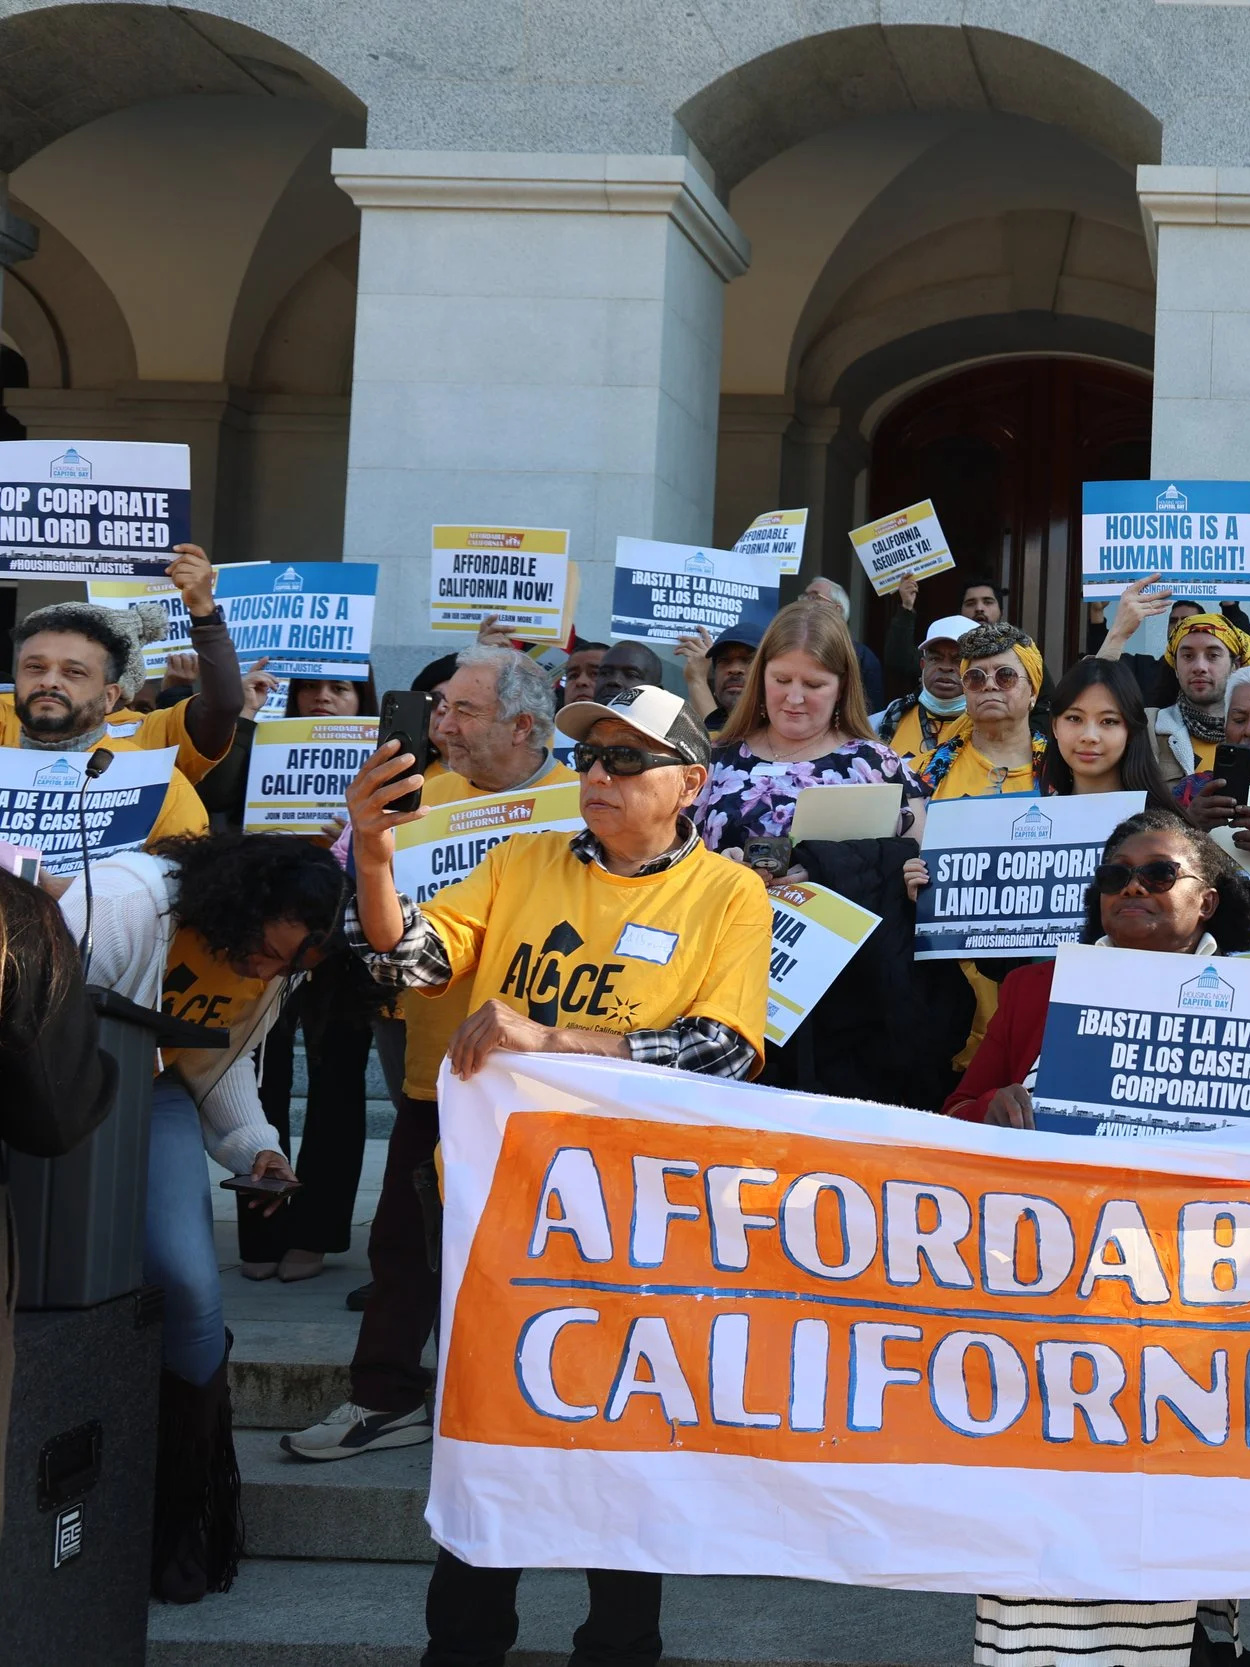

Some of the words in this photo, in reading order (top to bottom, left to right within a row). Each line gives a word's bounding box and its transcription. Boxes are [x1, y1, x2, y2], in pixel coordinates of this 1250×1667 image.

[38, 488, 169, 518] CORPORATE
[98, 520, 170, 547] GREED
[1106, 515, 1192, 540] HOUSING
[1200, 515, 1218, 540] IS
[1225, 516, 1239, 540] A
[772, 541, 797, 553] NOW!
[872, 526, 921, 555] CALIFORNIA
[10, 560, 134, 574] #HOUSINGDIGNITYJUSTICE
[453, 554, 537, 577] AFFORDABLE
[872, 545, 916, 572] ASEQUIBLE
[915, 538, 932, 554] YA!
[1099, 545, 1173, 571] HUMAN
[1181, 546, 1245, 571] RIGHT!
[439, 578, 507, 599] CALIFORNIA
[513, 581, 553, 602] NOW!
[632, 571, 672, 588] ¡BASTA
[675, 575, 690, 589] DE
[693, 578, 707, 592] LA
[709, 580, 760, 600] AVARICIA
[229, 596, 303, 621] HOUSING
[310, 596, 331, 619] IS
[335, 596, 348, 620] A
[651, 588, 666, 602] DE
[669, 591, 691, 605] LOS
[694, 595, 743, 613] CASEROS
[653, 604, 740, 627] CORPORATIVOS!
[228, 624, 284, 650] UMAN
[288, 625, 354, 650] RIGHT!
[286, 748, 374, 769] AFFORDA
[261, 774, 352, 795] CALIFORN
[14, 792, 39, 809] DE
[41, 793, 61, 810] LA
[67, 789, 141, 810] AVARICIA
[2, 812, 35, 830] LOS
[40, 811, 114, 830] CASEROS
[265, 812, 280, 820] JOIN
[282, 812, 295, 820] OUR
[450, 816, 506, 832] CALIFORNIA
[451, 805, 508, 822] AFFORDABLE
[937, 852, 991, 882] STOP
[934, 886, 1044, 917] LANDLORD
[965, 933, 1080, 949] #HOUSINGDIGNITYJUSTICE
[500, 942, 625, 1016] ACCE
[1182, 998, 1212, 1007] CAPITOL
[1215, 1000, 1229, 1009] DAY
[1183, 991, 1211, 999] HOUSING
[1213, 993, 1230, 1001] NOW!
[1077, 1008, 1152, 1040] ¡BASTA
[1157, 1015, 1186, 1043] DE
[1190, 1018, 1217, 1045] LA
[1111, 1043, 1141, 1070] DE
[1144, 1046, 1184, 1075] LOS
